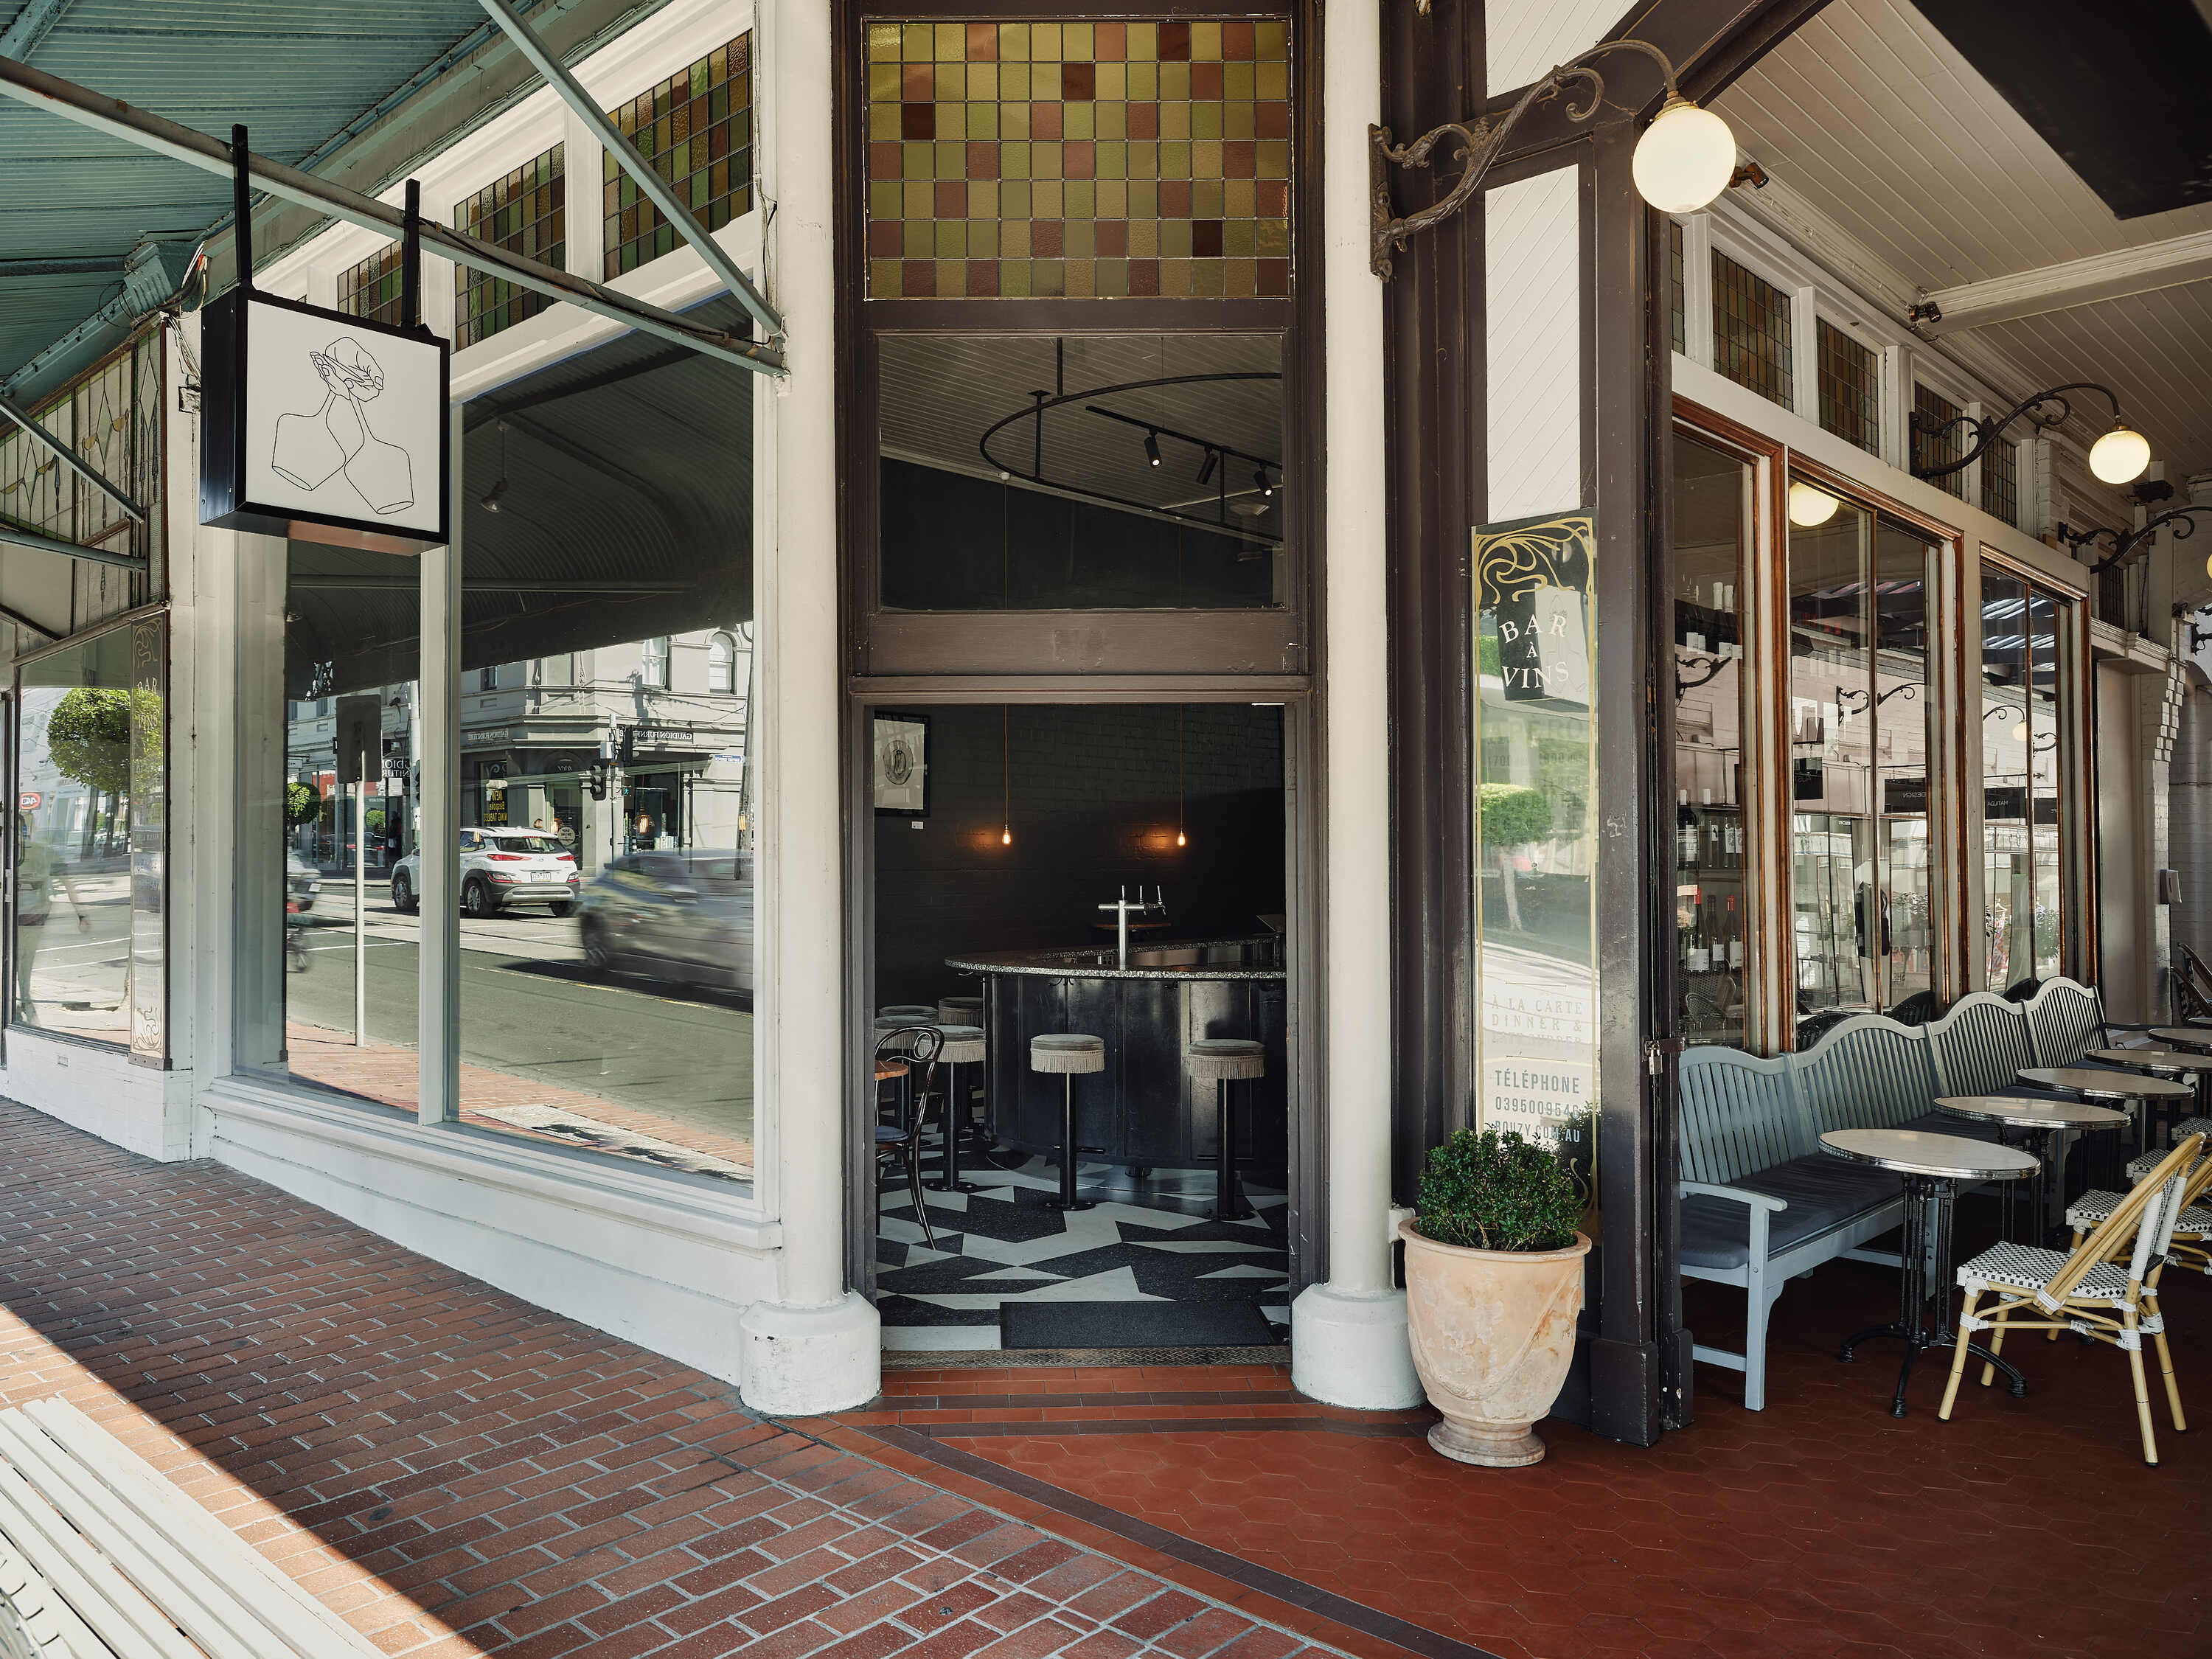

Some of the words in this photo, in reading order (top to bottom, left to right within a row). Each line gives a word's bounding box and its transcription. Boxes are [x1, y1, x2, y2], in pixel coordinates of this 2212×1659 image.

[1499, 613, 1567, 644] BAR
[1526, 641, 1540, 658] À
[1501, 661, 1569, 689] VINS
[1535, 999, 1582, 1015] CARTE
[1495, 1068, 1580, 1094] TÉLÉPHONE
[1495, 1096, 1579, 1119] 0395009546
